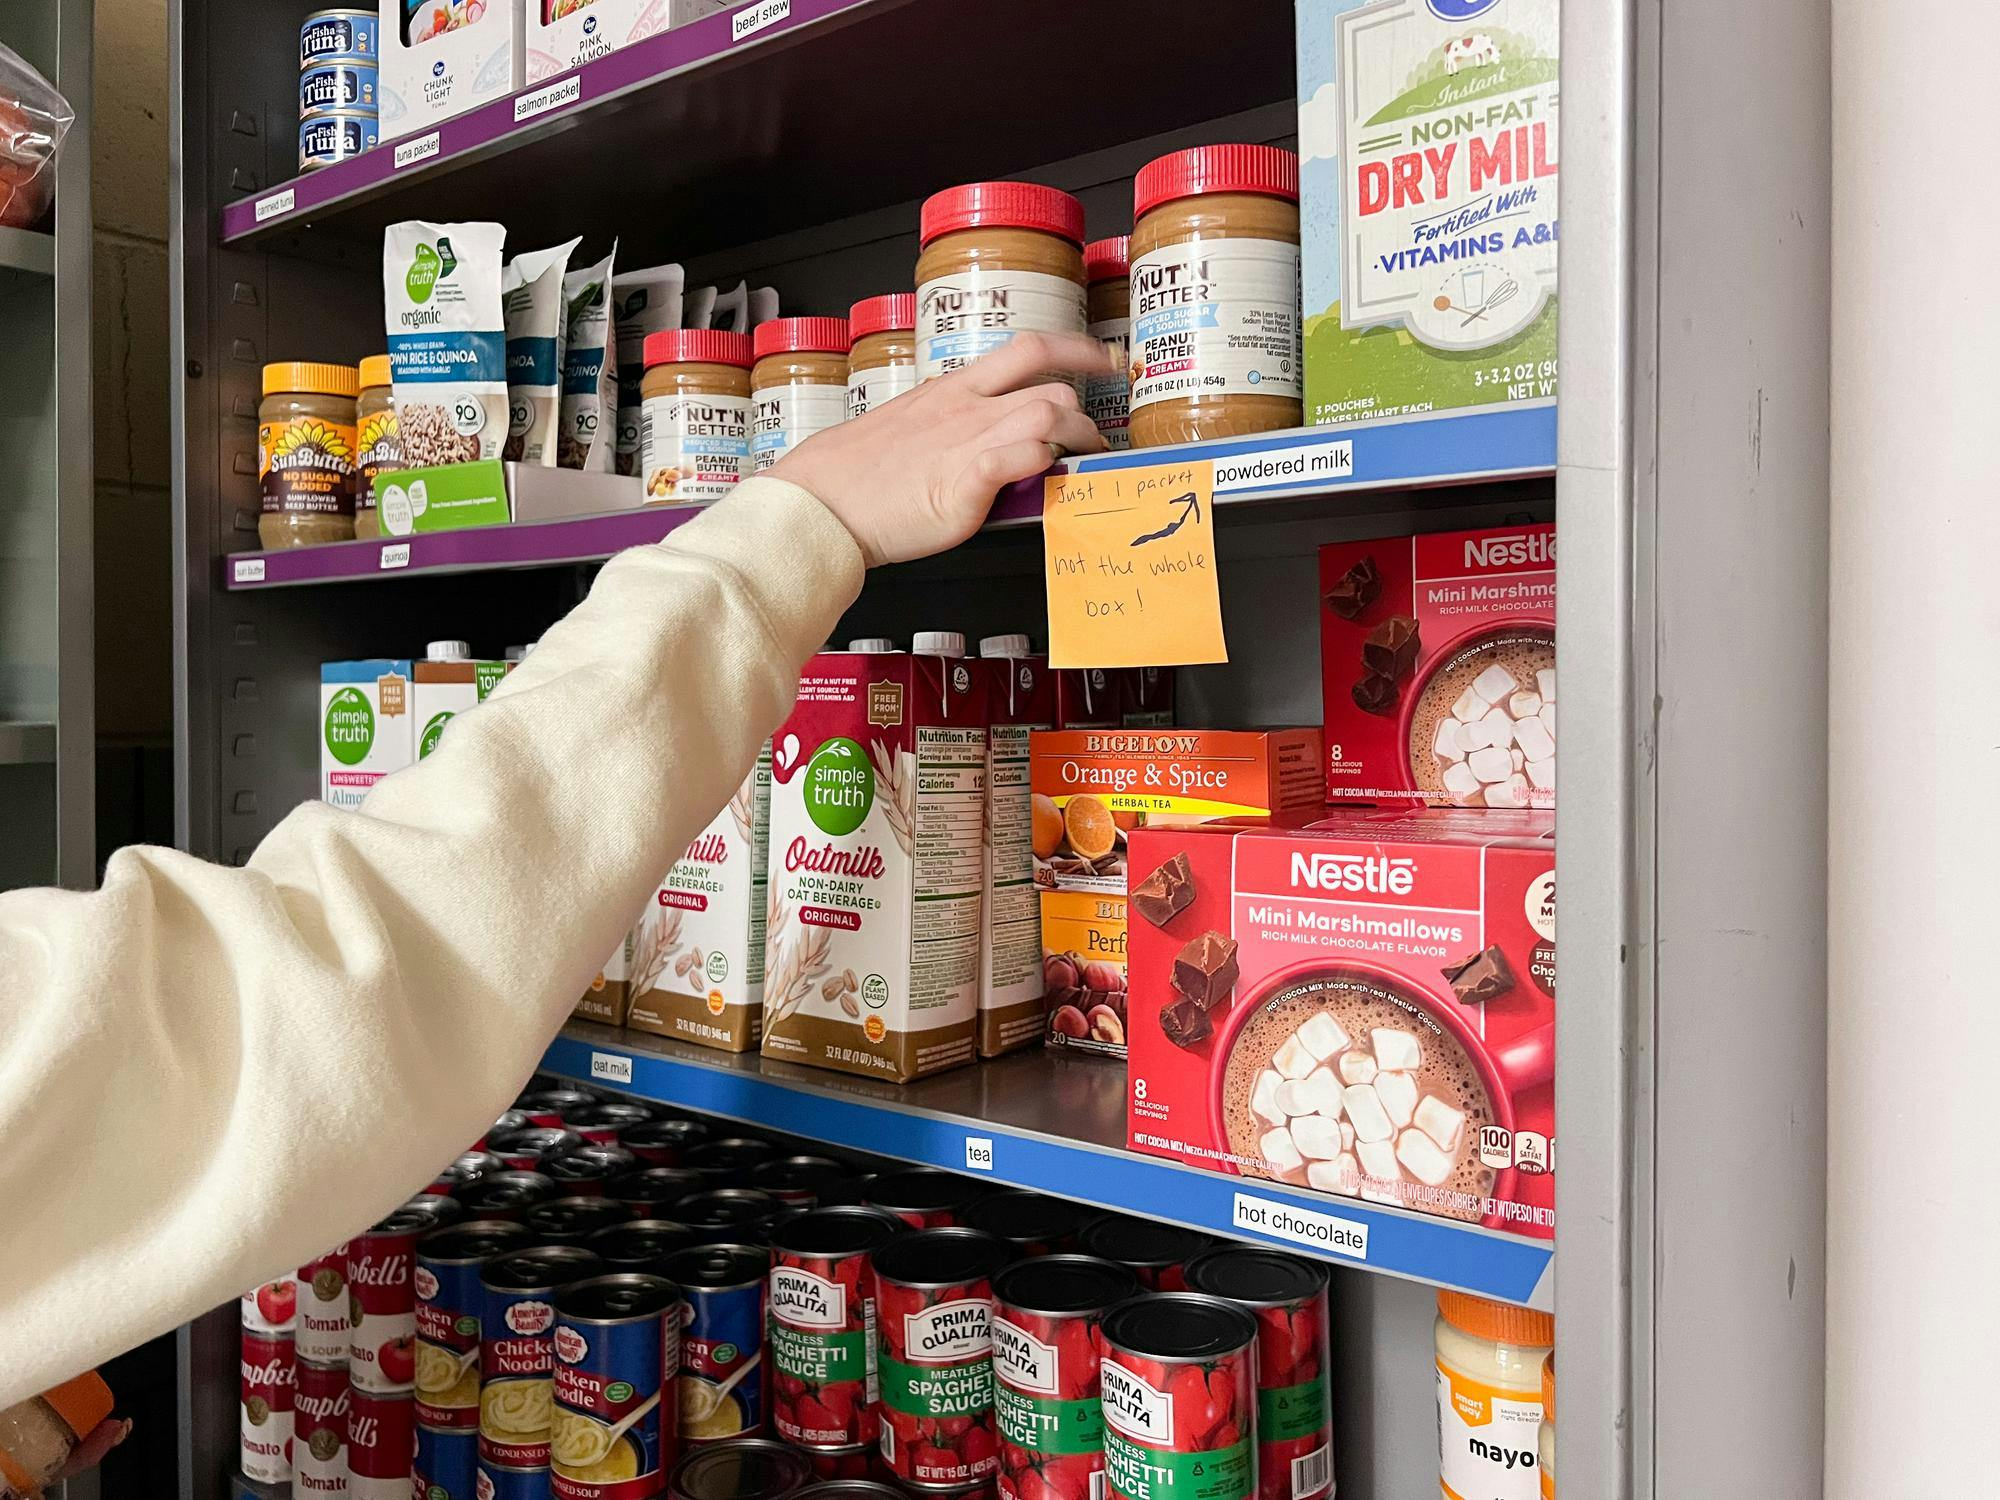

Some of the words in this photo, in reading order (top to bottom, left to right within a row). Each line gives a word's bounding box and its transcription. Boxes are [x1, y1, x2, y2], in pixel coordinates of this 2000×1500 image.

[736, 13, 759, 33] beef
[762, 0, 789, 21] stew
[312, 25, 335, 36] Fisha
[303, 34, 346, 56] Tuna
[579, 33, 602, 51] PINK
[571, 43, 611, 68] SALMON
[424, 75, 454, 92] CHUNK
[1435, 67, 1506, 105] Instant
[426, 87, 451, 103] LIGHT
[517, 94, 547, 115] salmon
[550, 83, 579, 105] packet
[1412, 96, 1538, 146] NON-FAT
[397, 145, 412, 162] tuna
[414, 139, 439, 157] packet
[1359, 142, 1458, 216] DRY
[257, 202, 277, 218] canned
[279, 195, 293, 210] tuna
[1414, 199, 1492, 244] Fortified
[1496, 186, 1537, 213] With
[1380, 232, 1504, 273] VITAMINS
[409, 271, 434, 286] truth
[1139, 260, 1208, 296] NUT'N
[401, 306, 441, 329] organic
[1138, 312, 1171, 330] REDUCED
[1156, 319, 1194, 333] SODIUM
[1145, 331, 1198, 352] PEANUT
[409, 352, 428, 365] RICE
[436, 349, 478, 363] QUINOA
[1146, 344, 1196, 365] BUTTER
[1150, 359, 1190, 375] CREAMY
[1515, 364, 1534, 380] OZ
[1154, 383, 1163, 393] 16
[1165, 380, 1175, 390] OZ
[1203, 375, 1226, 387] 454g
[1508, 381, 1534, 400] NET
[455, 405, 477, 421] 90
[687, 408, 745, 424] NUT'N
[1316, 405, 1322, 416] 3
[1325, 398, 1374, 413] POUCHES
[1402, 402, 1433, 413] EACH
[688, 424, 746, 437] BETTER
[696, 455, 739, 465] PEANUT
[697, 464, 739, 473] BUTTER
[1216, 454, 1304, 486] powdered
[1311, 449, 1350, 473] milk
[283, 471, 299, 481] NO
[301, 472, 340, 483] SUGAR
[291, 481, 332, 492] ADDED
[1056, 481, 1095, 505] Just
[1136, 470, 1194, 499] packet
[384, 551, 408, 564] quinoa
[1098, 554, 1134, 577] the
[1149, 550, 1205, 577] whole
[1428, 586, 1465, 603] Mini
[1439, 605, 1462, 615] RICH
[1466, 604, 1488, 613] MILK
[1491, 600, 1554, 612] CHOCOLATE
[874, 695, 896, 703] FREE
[332, 709, 369, 729] simple
[332, 726, 369, 743] truth
[919, 730, 963, 743] Nutrition
[993, 728, 1027, 739] Nutrition
[1086, 735, 1198, 754] BIGELOW
[1332, 745, 1342, 760] 8
[814, 765, 865, 785] simple
[918, 779, 955, 789] Calories
[994, 773, 1022, 783] Calories
[1062, 761, 1137, 792] Orange
[1144, 764, 1162, 786] &
[1169, 763, 1228, 794] Spice
[814, 785, 864, 807] truth
[1112, 798, 1149, 808] HERBAL
[1153, 799, 1171, 809] TEA
[785, 835, 886, 879] Oatmilk
[670, 877, 718, 892] BEVERAGE
[1040, 869, 1053, 883] 20
[799, 876, 863, 895] NON-DAIRY
[663, 893, 703, 909] ORIGINAL
[787, 888, 810, 901] OAT
[813, 892, 874, 910] BEVERAGE
[804, 910, 855, 928] ORIGINAL
[1248, 907, 1291, 926] Mini
[1298, 911, 1463, 943] Marshmallows
[1088, 929, 1127, 952] Perf
[1261, 930, 1288, 942] RICH
[1290, 932, 1317, 945] MILK
[1320, 936, 1394, 953] CHOCOLATE
[1398, 943, 1447, 957] FLAVOR
[864, 992, 886, 1002] BASED
[865, 985, 886, 995] PLANT
[1266, 999, 1281, 1012] HOT
[1281, 986, 1308, 1003] COCOA
[1308, 983, 1323, 991] MIX
[1326, 981, 1349, 989] Made
[1350, 983, 1368, 993] with
[1370, 988, 1386, 999] real
[1417, 1011, 1442, 1036] Cocoa
[1052, 1031, 1066, 1044] 20
[594, 1060, 609, 1074] oat
[611, 1061, 630, 1077] milk
[1134, 1079, 1147, 1099] 8
[1134, 1099, 1169, 1113] DELICIOUS
[1134, 1108, 1168, 1121] SERVINGS
[1134, 1132, 1148, 1144] HOT
[1148, 1135, 1170, 1150] COCOA
[1482, 1129, 1509, 1148] 100
[968, 1146, 990, 1162] tea
[1482, 1147, 1509, 1158] CALORIES
[1520, 1150, 1531, 1158] SAT
[1531, 1152, 1542, 1160] FAT
[1480, 1197, 1497, 1215] NET
[1239, 1201, 1266, 1225] hot
[1272, 1212, 1364, 1249] chocolate
[777, 1277, 821, 1298] PRIMA
[932, 1308, 986, 1330] PRIMA
[777, 1357, 827, 1378] SAUCE
[931, 1362, 989, 1379] MEATLESS
[929, 1389, 992, 1413] SAUCE
[1455, 1391, 1484, 1410] smart
[1458, 1403, 1482, 1420] way
[493, 1447, 545, 1459] CONDENSED
[576, 1487, 601, 1499] SOUP
